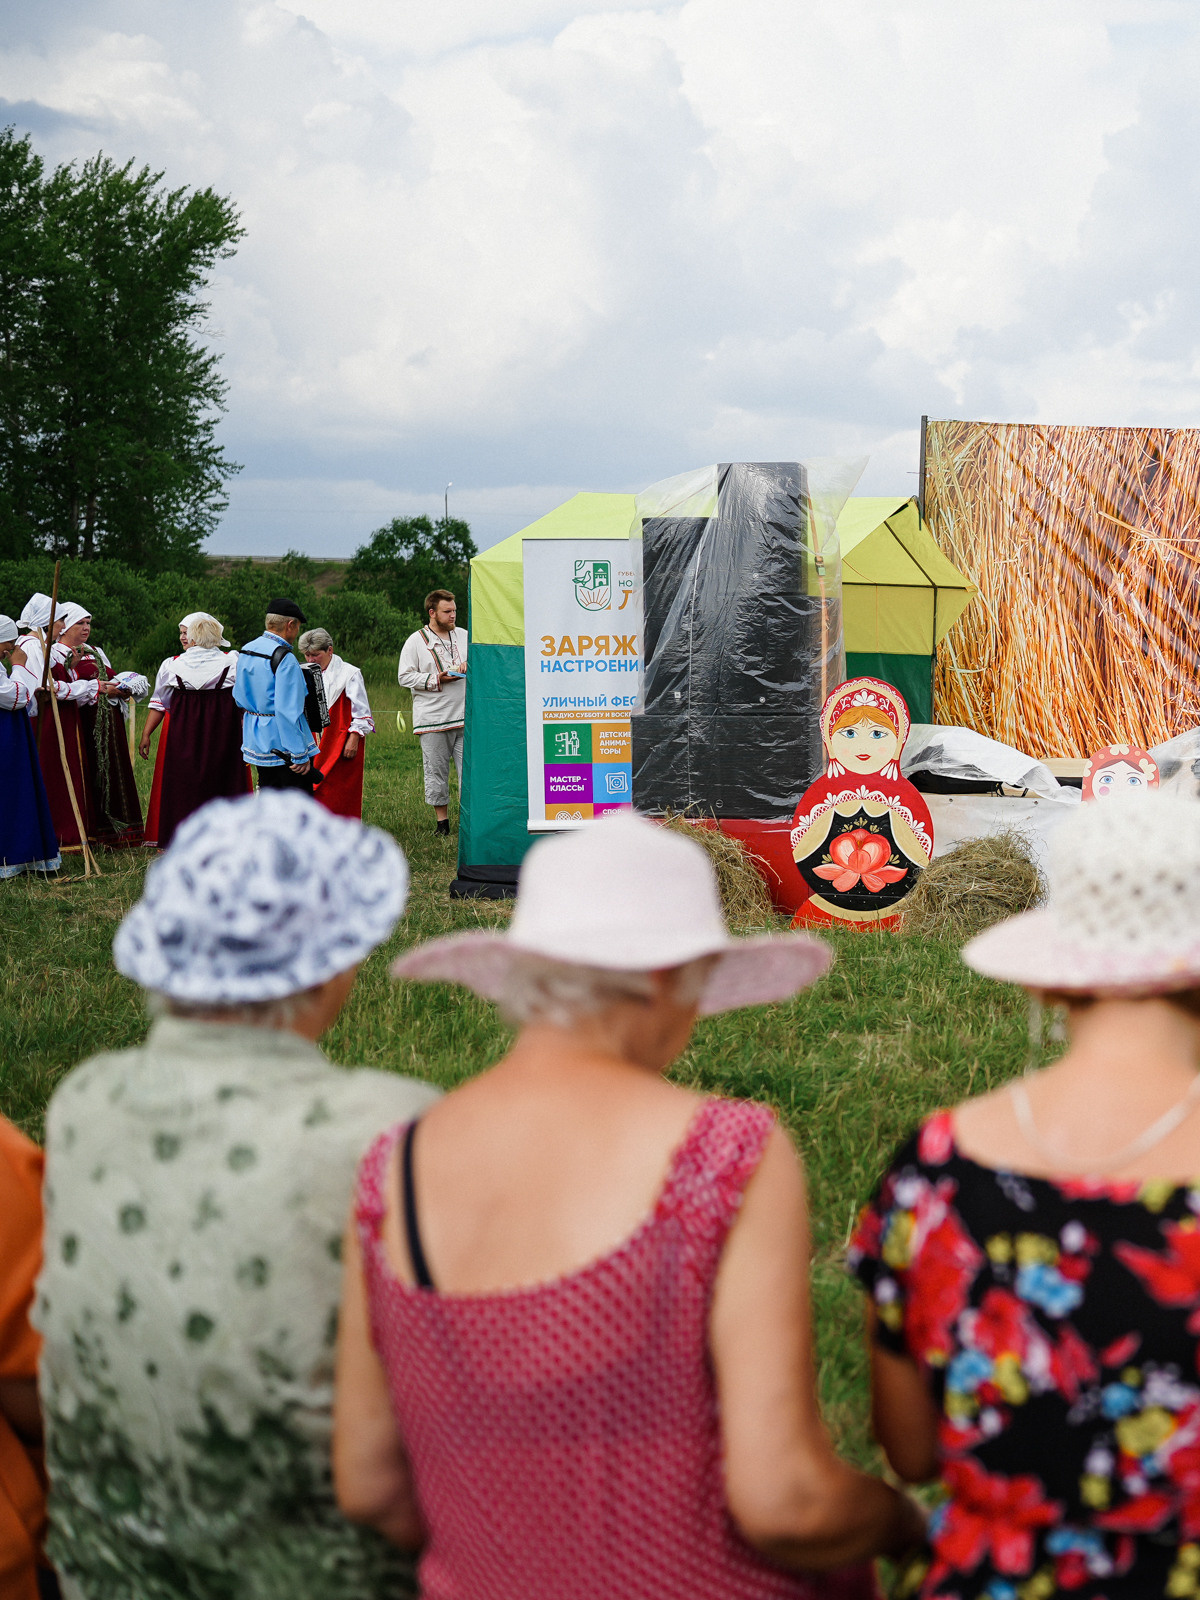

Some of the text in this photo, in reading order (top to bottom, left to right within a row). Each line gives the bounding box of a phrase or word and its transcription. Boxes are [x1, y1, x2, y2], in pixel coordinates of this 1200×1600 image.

[540, 635, 639, 657] ЗАРЯЖ
[542, 693, 637, 707] УЛИЧНЫЙ ФЕС
